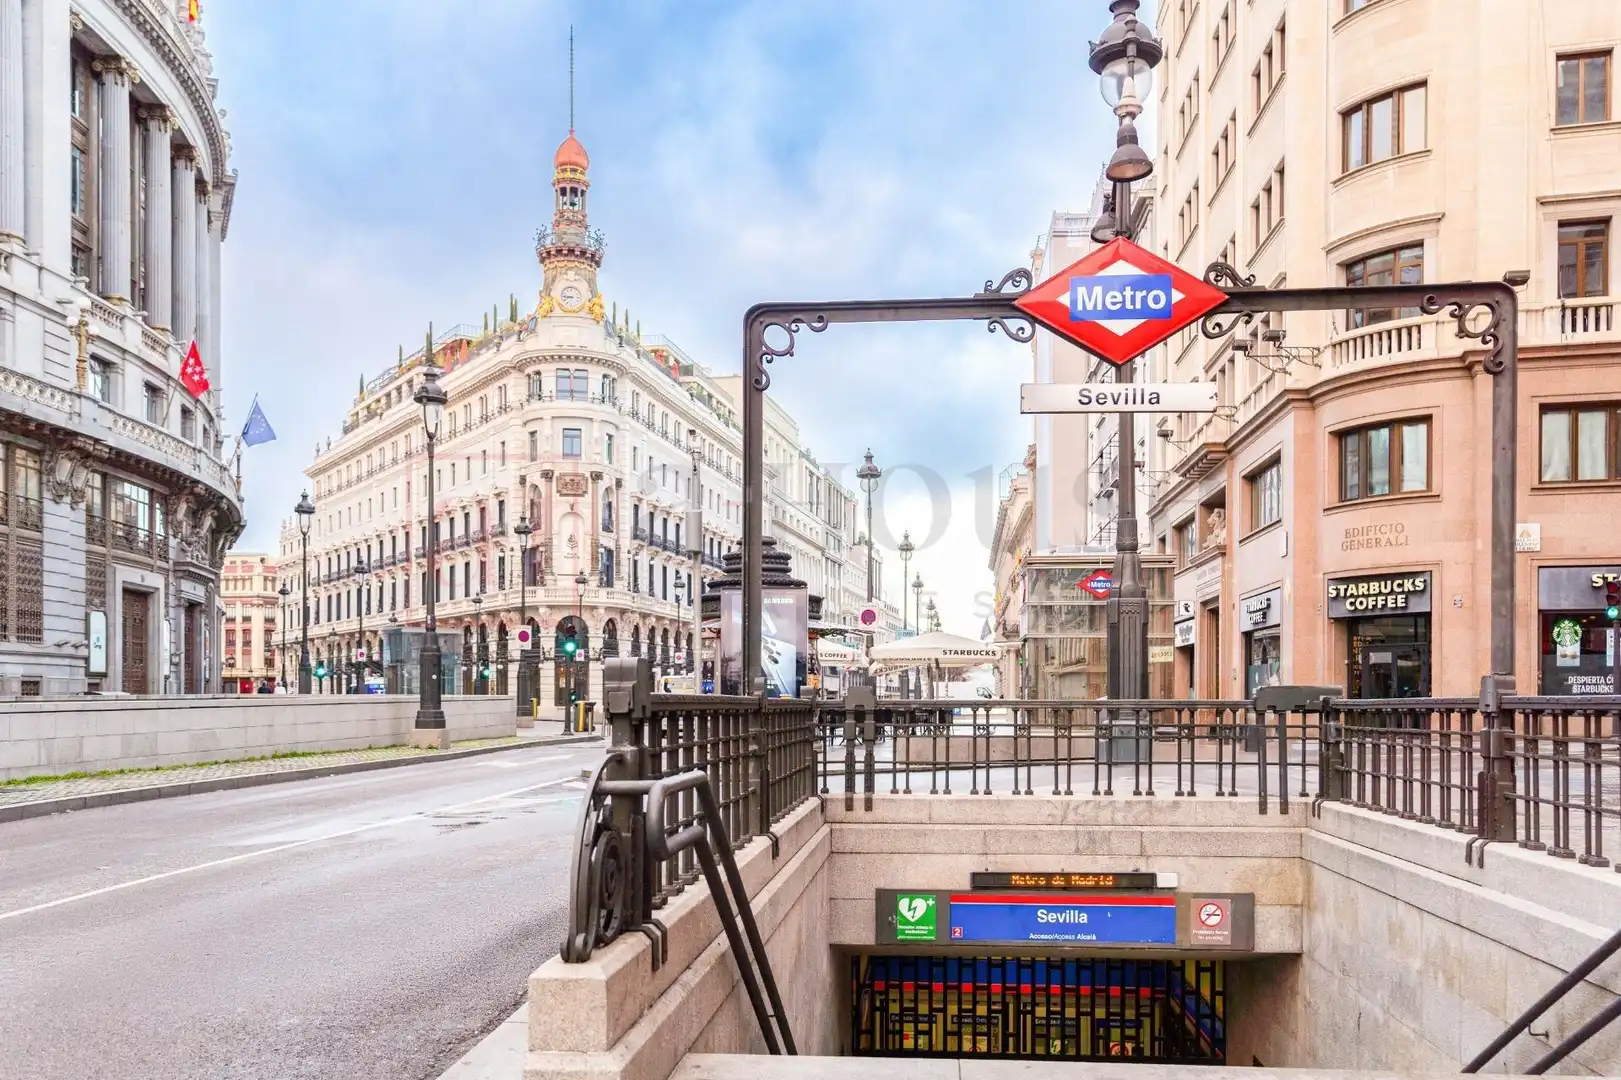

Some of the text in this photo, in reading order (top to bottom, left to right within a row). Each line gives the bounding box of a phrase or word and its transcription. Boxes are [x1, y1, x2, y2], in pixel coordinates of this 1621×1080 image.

[1076, 285, 1167, 312] Metro
[1078, 388, 1161, 405] Sevilla
[1343, 522, 1405, 539] EDIFICIO
[1341, 535, 1410, 552] GENERALI
[1328, 577, 1425, 598] STARBUCKS
[1345, 594, 1406, 611] COFFEE
[942, 649, 997, 657] STARBUCKS
[1568, 675, 1606, 684] DESPIERTA
[1572, 684, 1614, 694] STARBUCKS
[1011, 875, 1113, 885] Metro de Madrid
[1037, 909, 1088, 924] Sevilla
